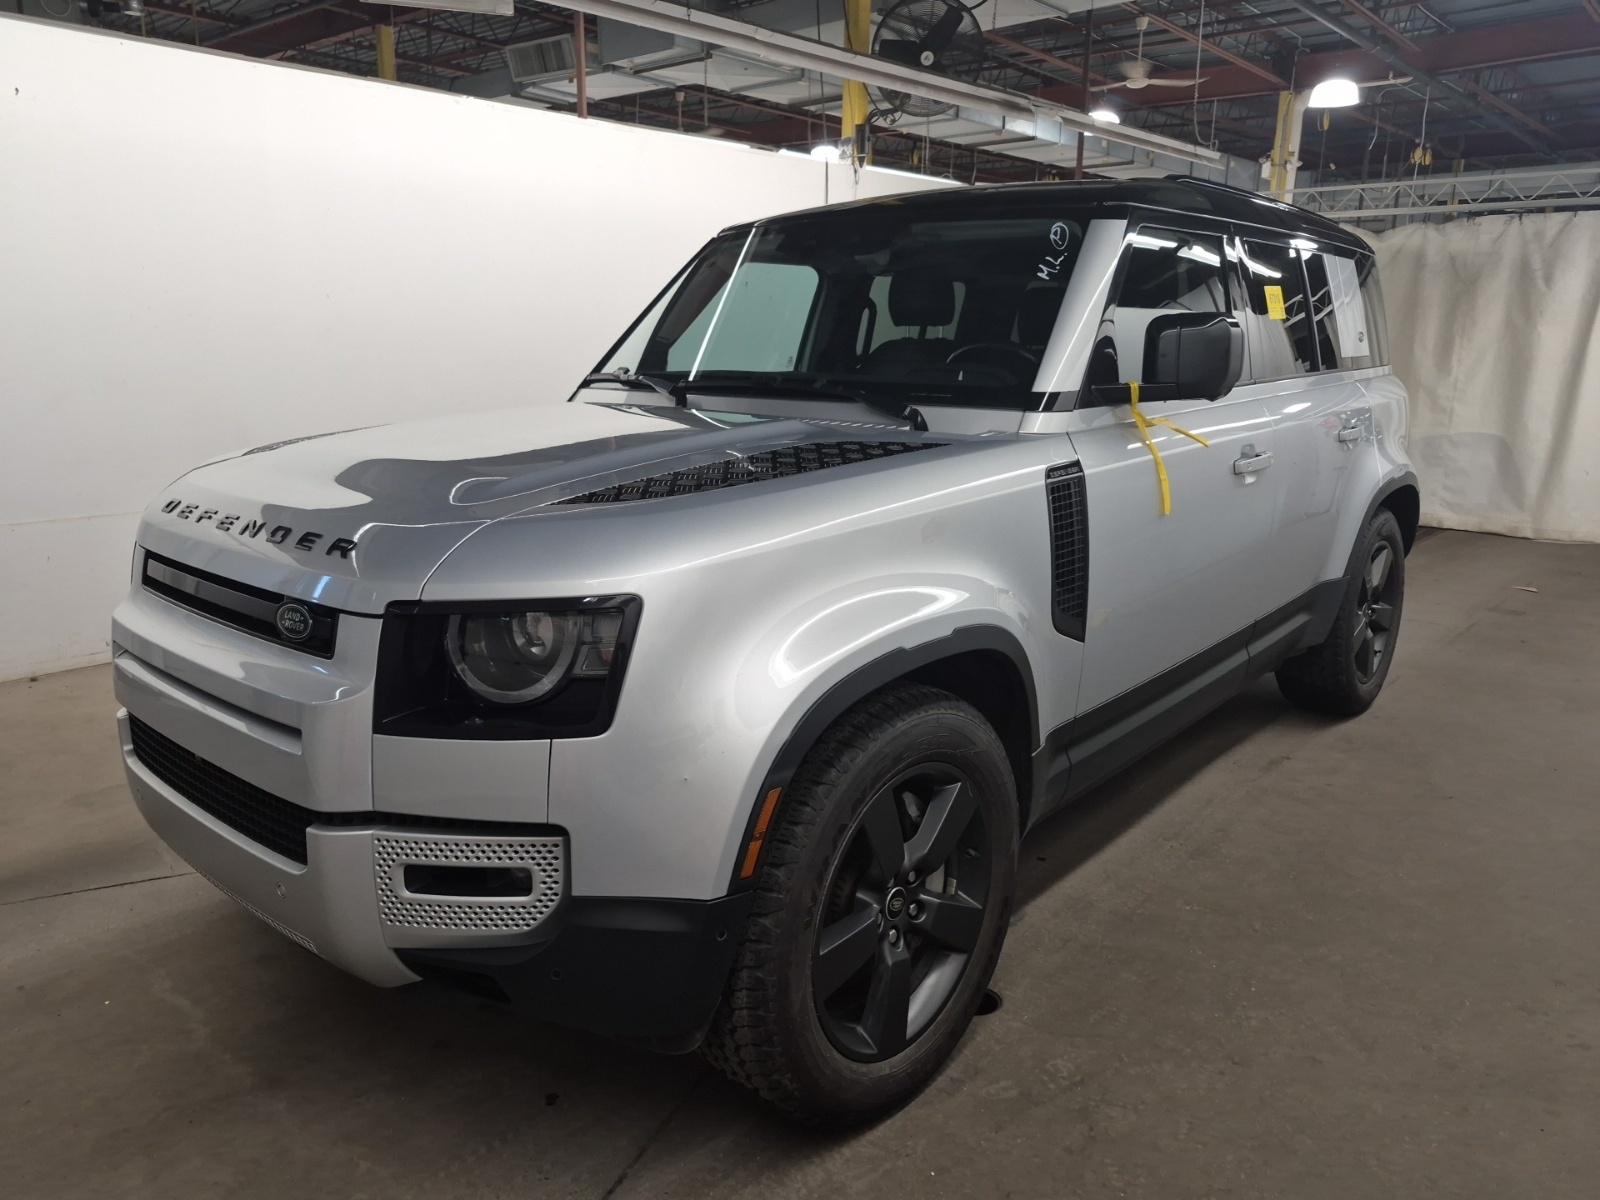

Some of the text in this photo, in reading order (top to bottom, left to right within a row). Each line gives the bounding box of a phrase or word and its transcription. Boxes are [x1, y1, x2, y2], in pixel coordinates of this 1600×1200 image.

[161, 498, 357, 559] DEFENDER
[284, 610, 301, 621] LAND
[284, 620, 304, 631] ROVER
